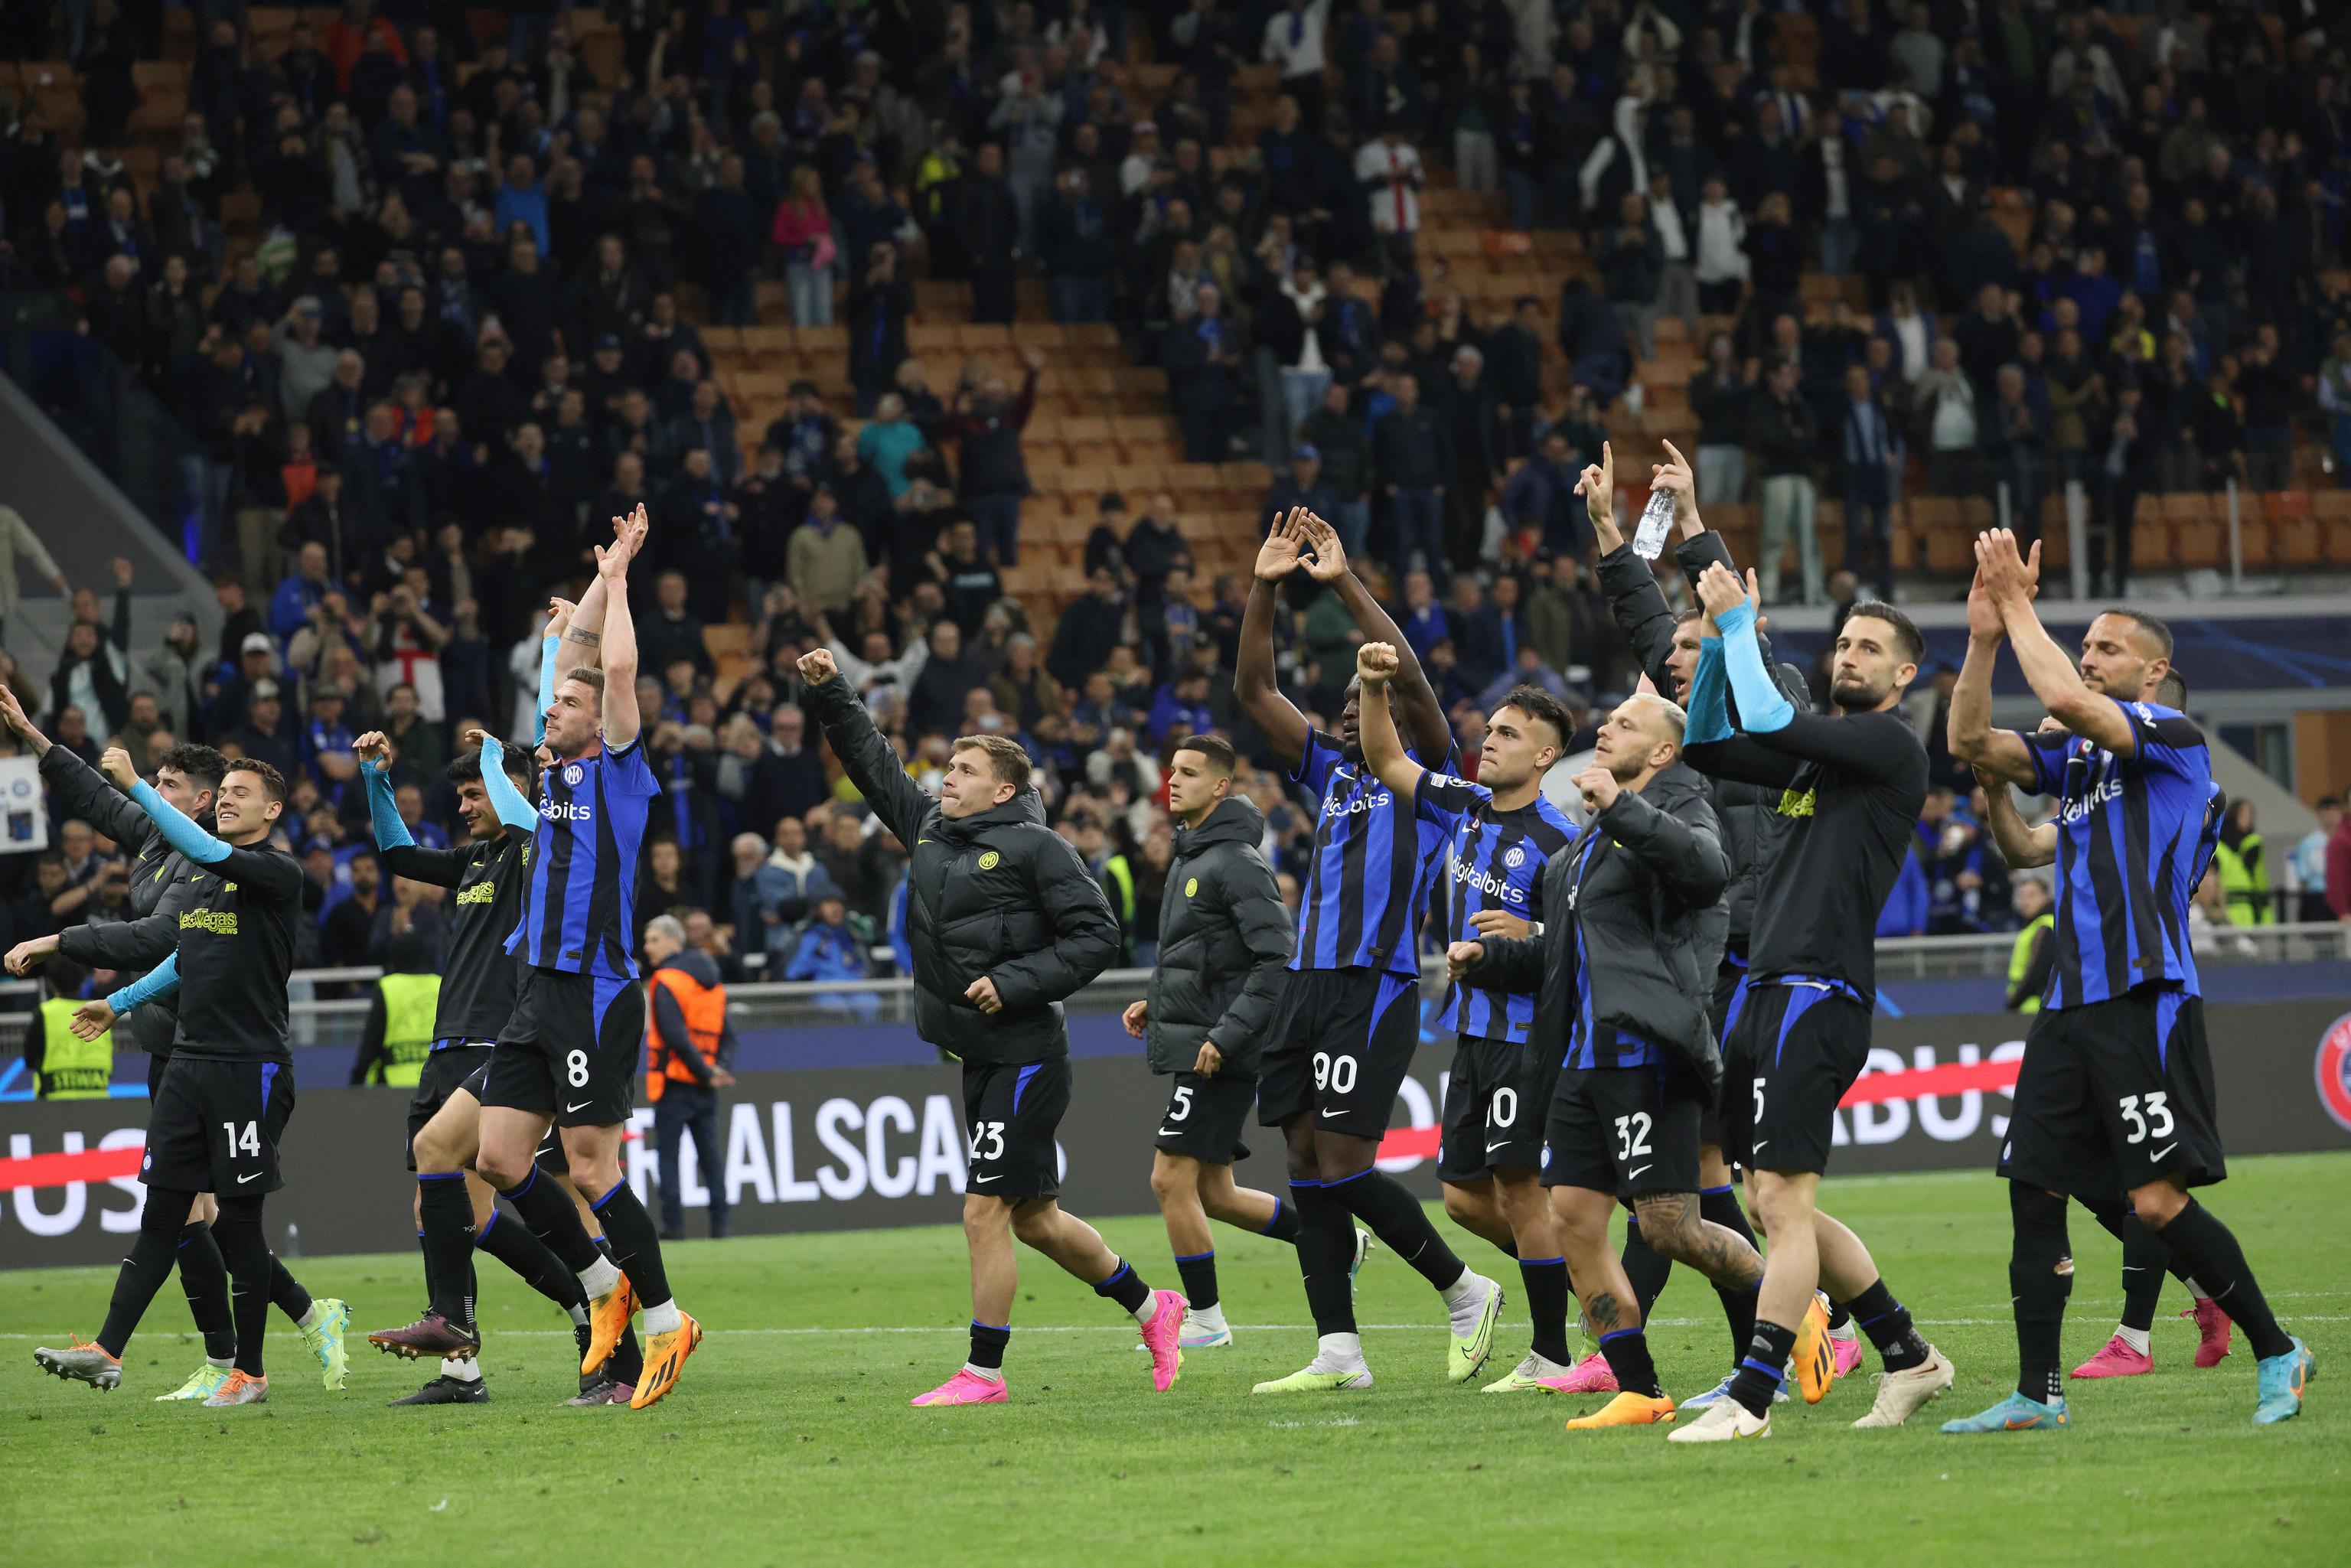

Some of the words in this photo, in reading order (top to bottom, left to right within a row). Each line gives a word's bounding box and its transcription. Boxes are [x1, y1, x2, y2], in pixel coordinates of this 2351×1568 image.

[1451, 855, 1524, 904] digitalbits
[566, 1048, 589, 1087] 8
[1312, 1051, 1358, 1094] 90
[1615, 1111, 1652, 1161] 32
[2119, 1090, 2174, 1144] 33
[223, 1120, 260, 1158] 14
[971, 1121, 1005, 1160] 23
